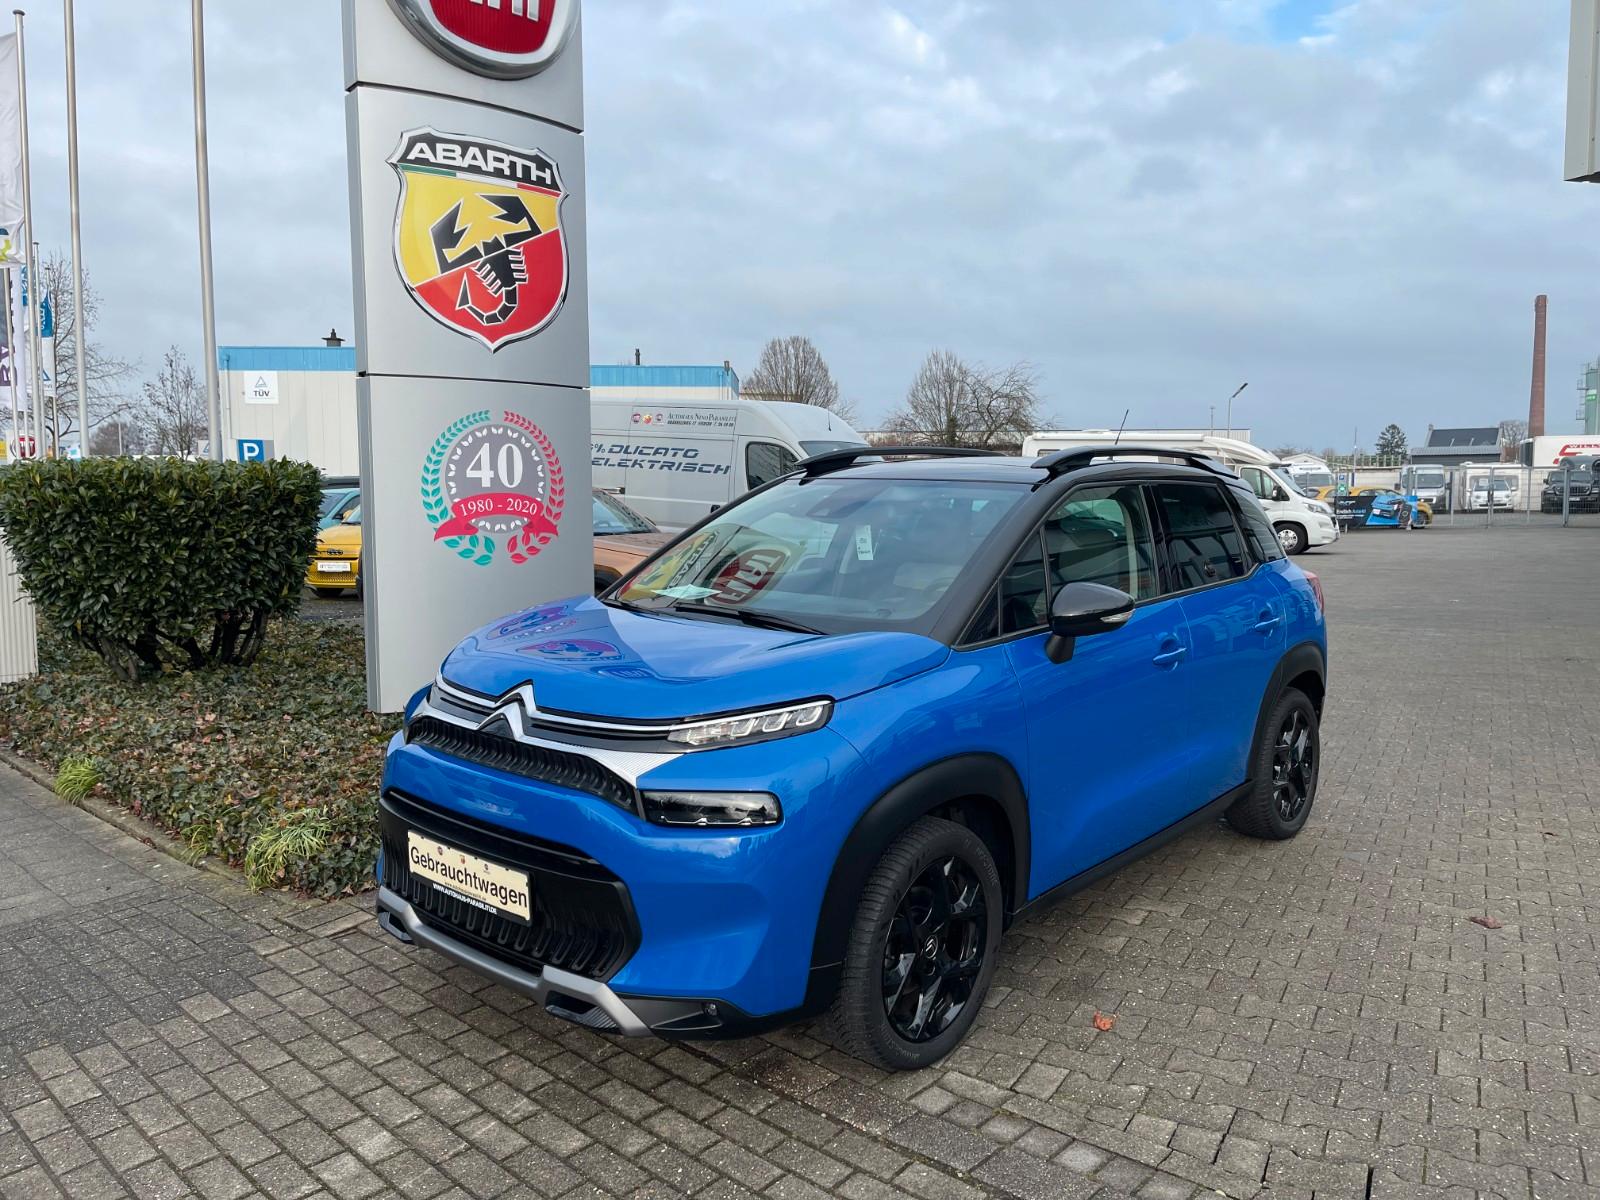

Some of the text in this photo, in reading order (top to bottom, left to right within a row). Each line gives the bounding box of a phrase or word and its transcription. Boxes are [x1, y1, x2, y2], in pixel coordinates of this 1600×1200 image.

[406, 142, 552, 185] ABARTH
[253, 389, 270, 397] TÜV
[243, 442, 260, 460] P
[608, 444, 699, 459] DUCATO
[466, 442, 523, 488] 40
[592, 457, 731, 475] ELEKTRISCH
[460, 498, 494, 516] 1980
[507, 498, 538, 516] 2020
[410, 846, 528, 908] Gebrauchtwagen
